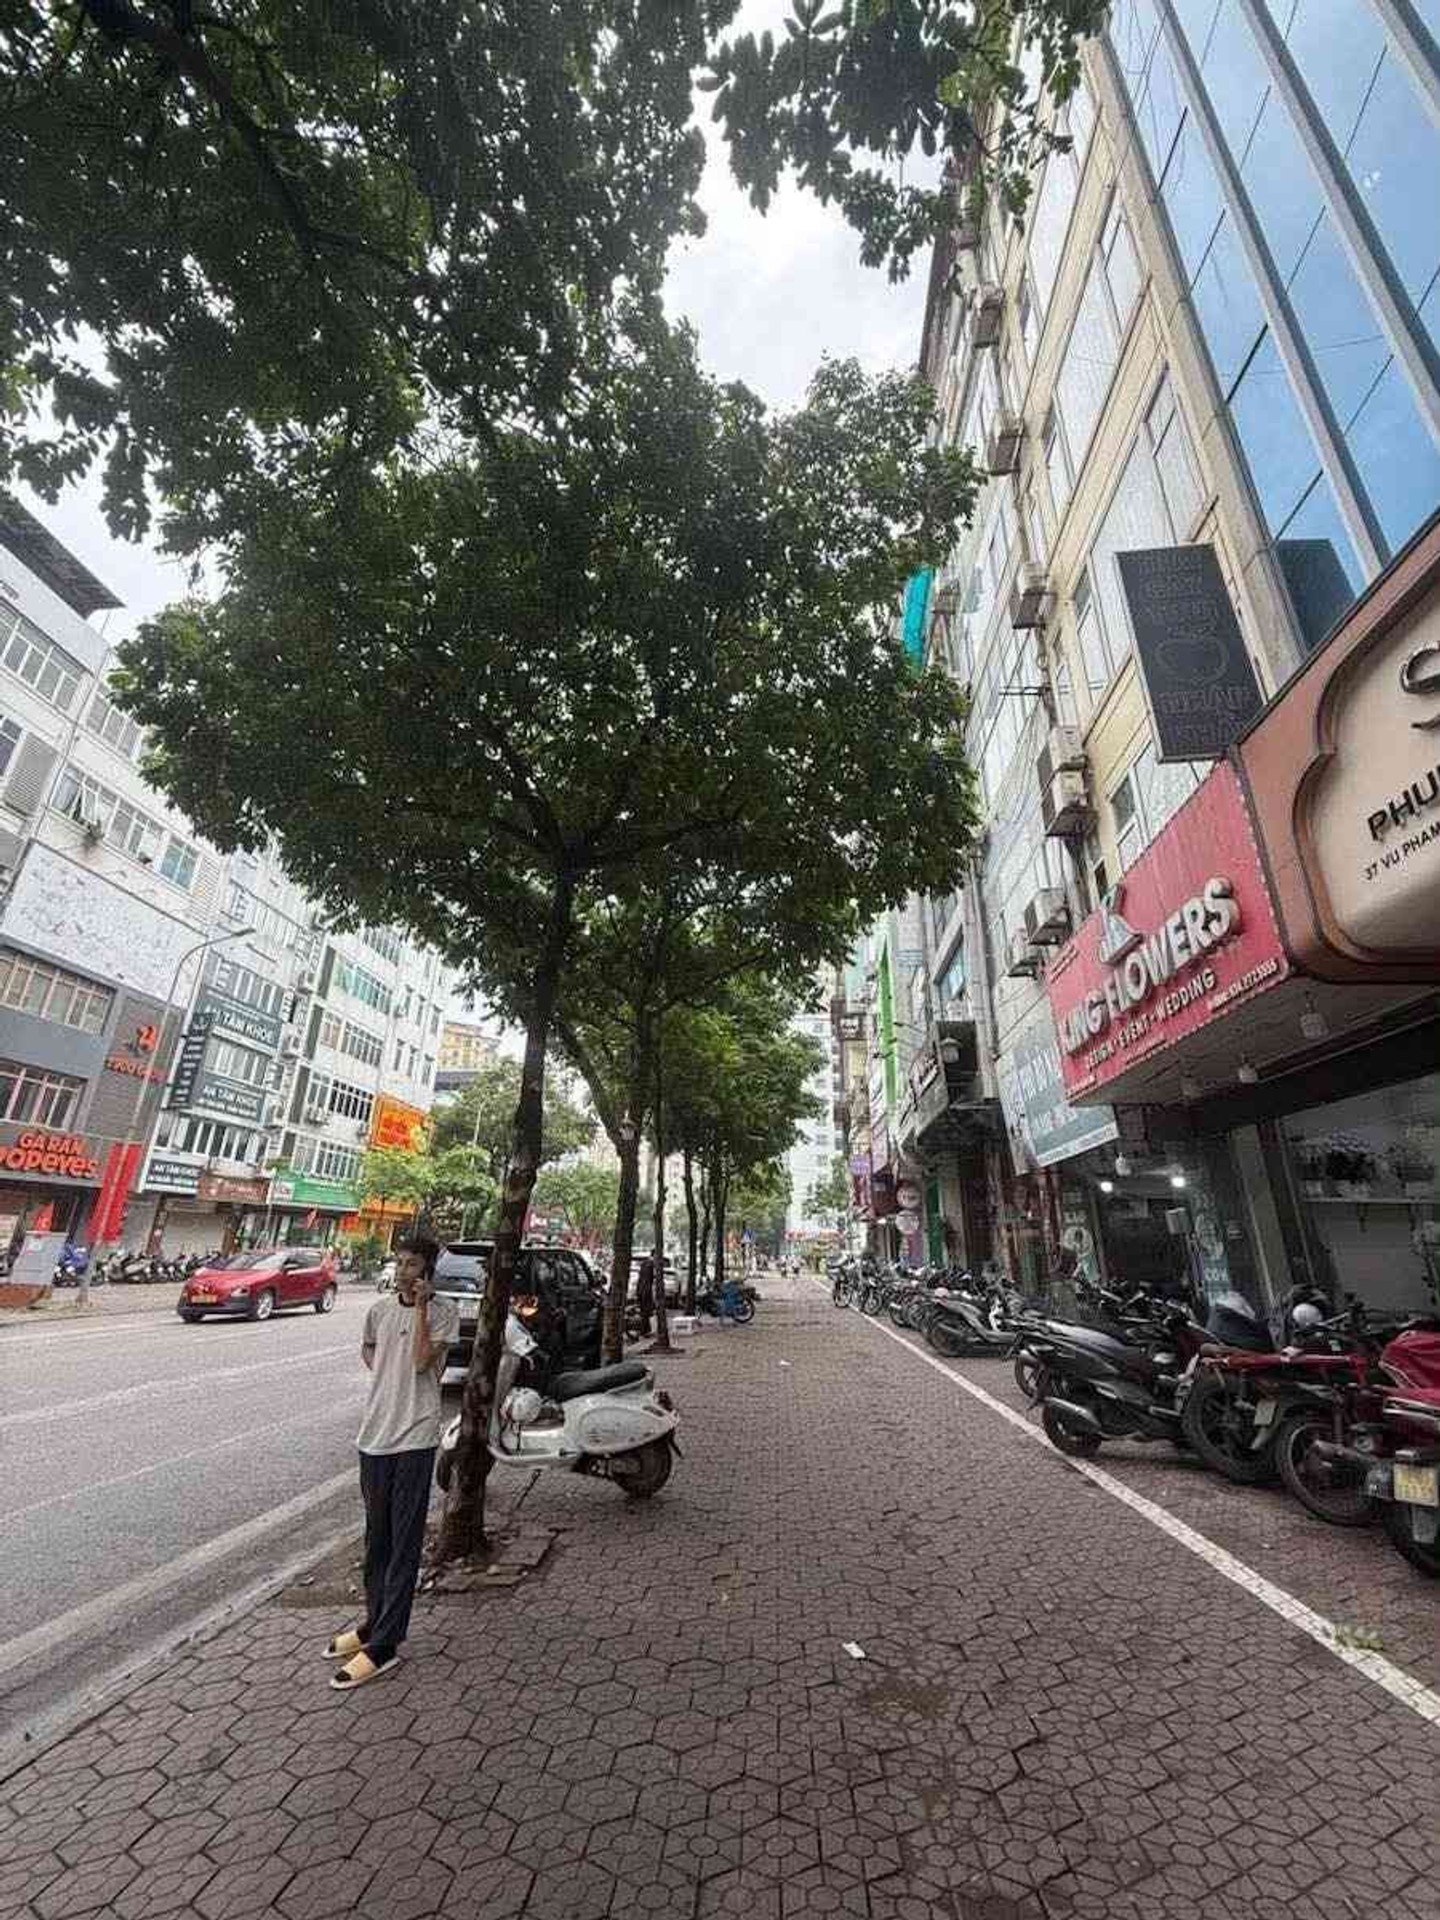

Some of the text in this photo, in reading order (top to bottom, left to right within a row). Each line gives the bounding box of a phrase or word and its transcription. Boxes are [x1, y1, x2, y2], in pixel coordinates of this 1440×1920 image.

[1367, 765, 1440, 841] PHU
[1364, 862, 1378, 880] 37
[1101, 876, 1238, 1018] FLOWERS
[1155, 967, 1216, 1022] WEDDING
